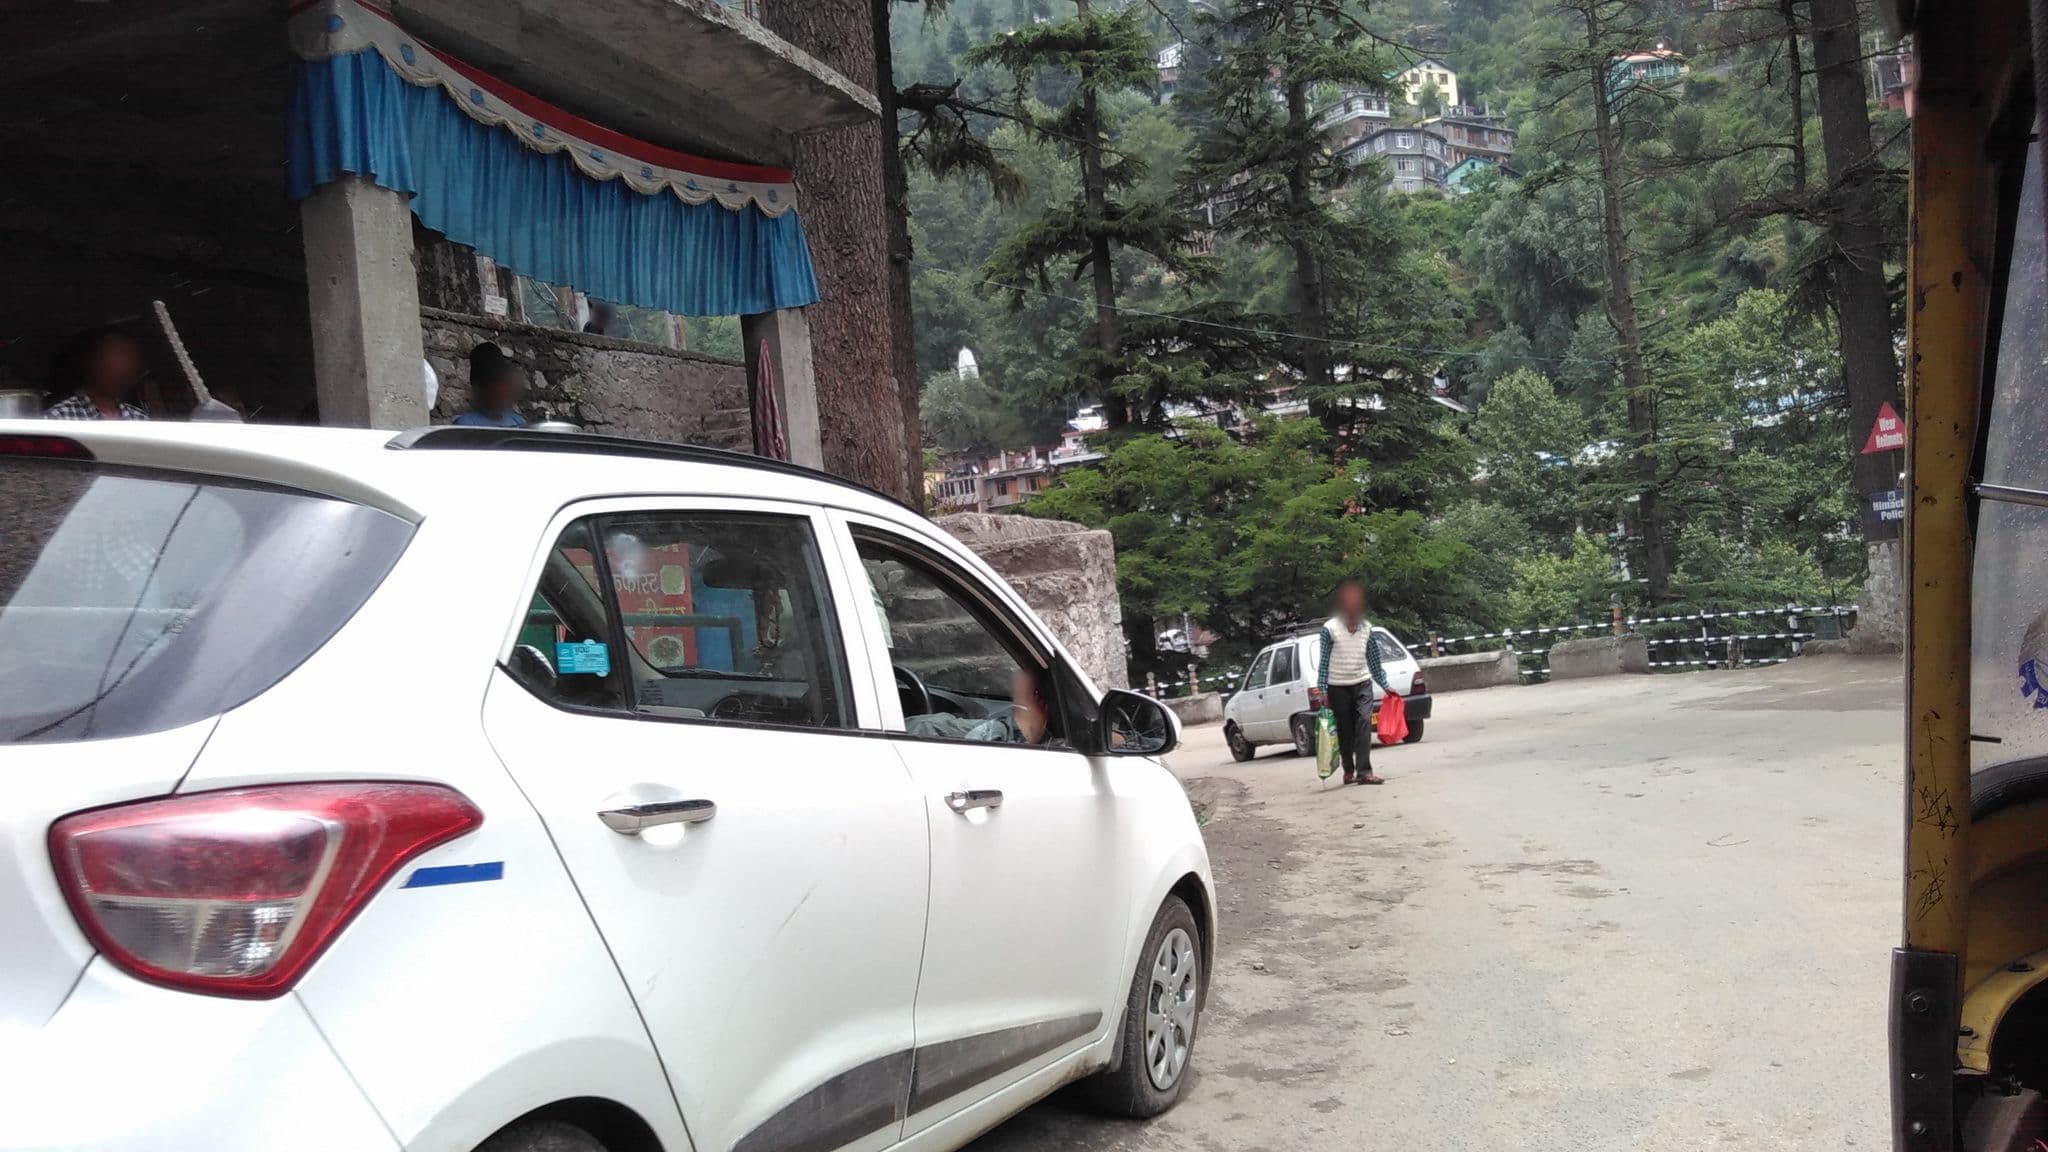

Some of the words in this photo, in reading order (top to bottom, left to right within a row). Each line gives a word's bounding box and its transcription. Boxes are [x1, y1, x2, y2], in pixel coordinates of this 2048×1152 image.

[1878, 417, 1896, 432] Wear
[1872, 498, 1905, 511] Himach
[1880, 510, 1905, 521] Polic
